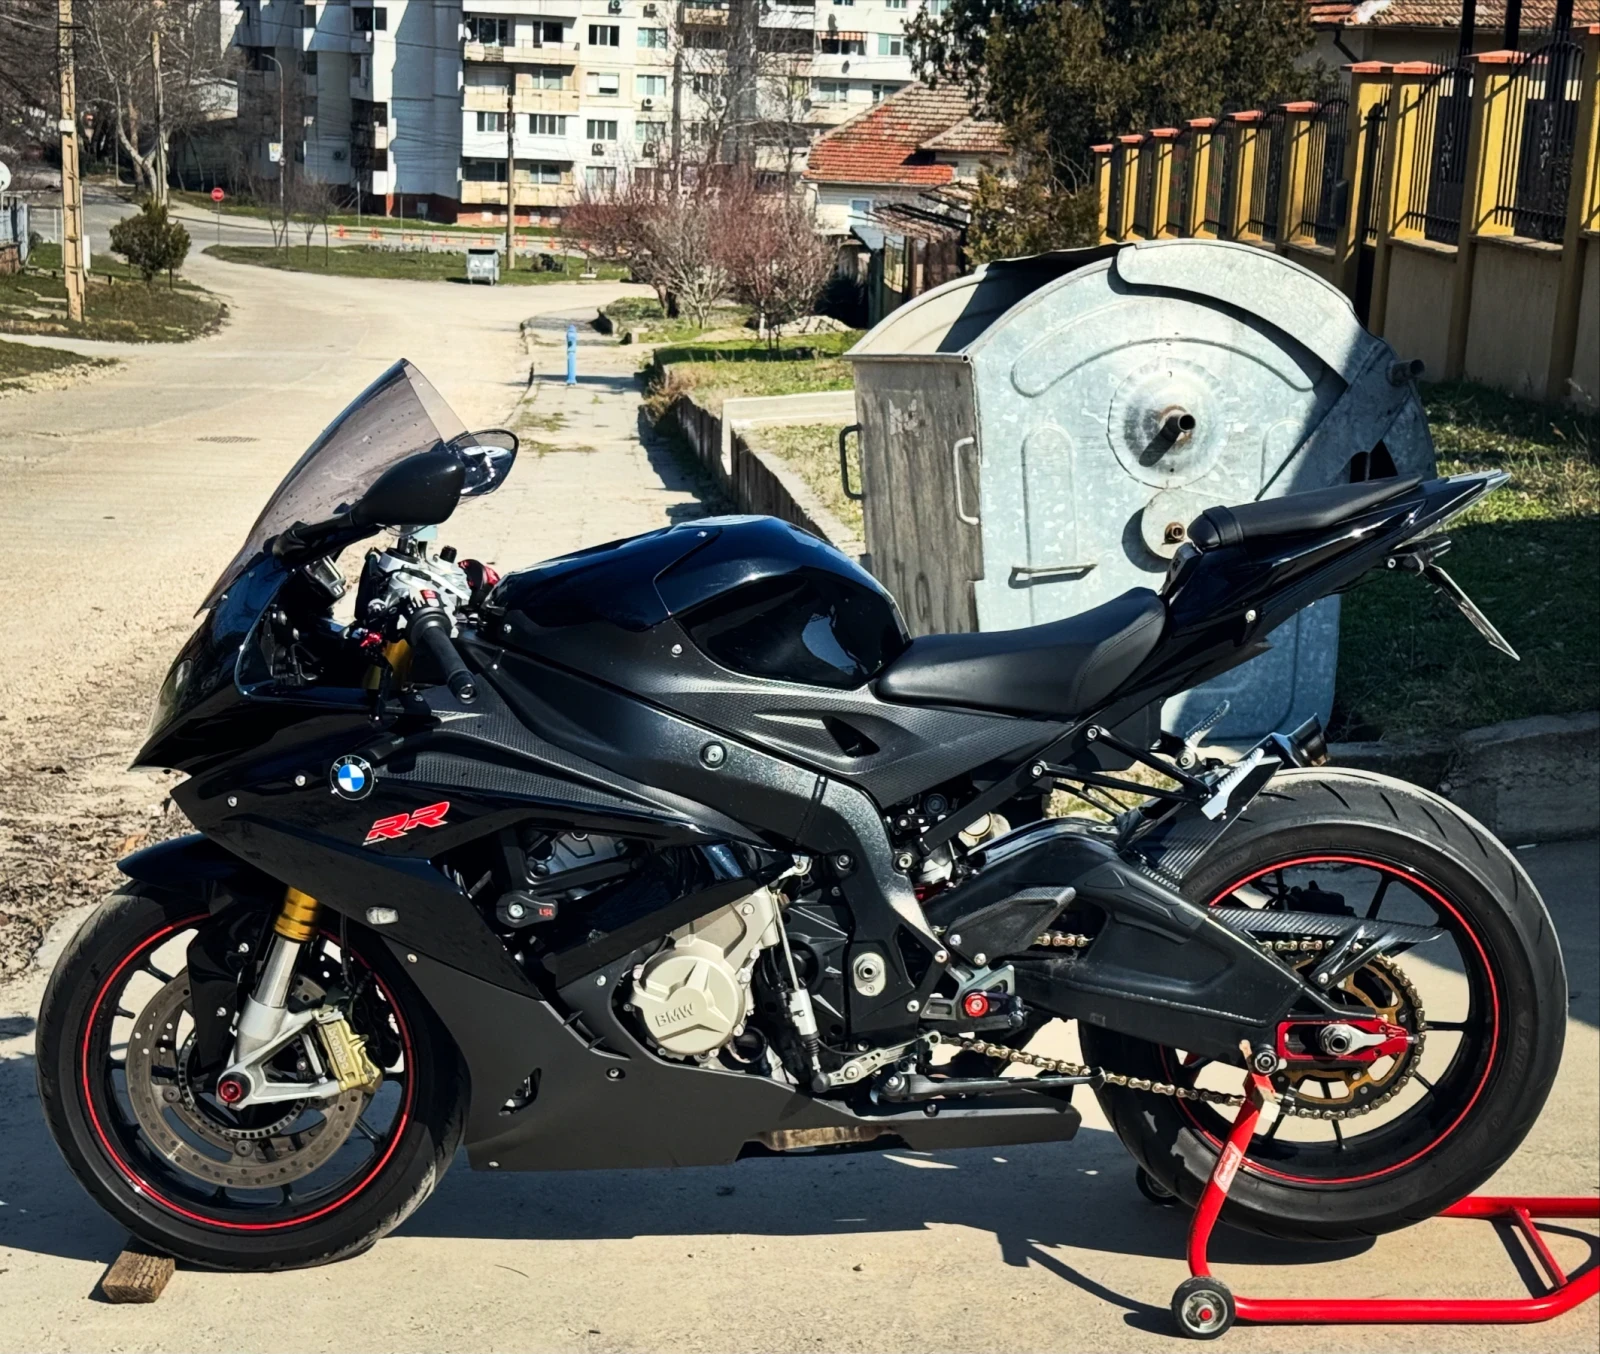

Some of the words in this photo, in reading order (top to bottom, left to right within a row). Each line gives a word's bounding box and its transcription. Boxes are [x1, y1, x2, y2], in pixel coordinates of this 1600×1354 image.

[332, 756, 369, 771] BMW
[365, 801, 450, 841] RR
[655, 1003, 695, 1027] BMW
[327, 1028, 350, 1071] brembo
